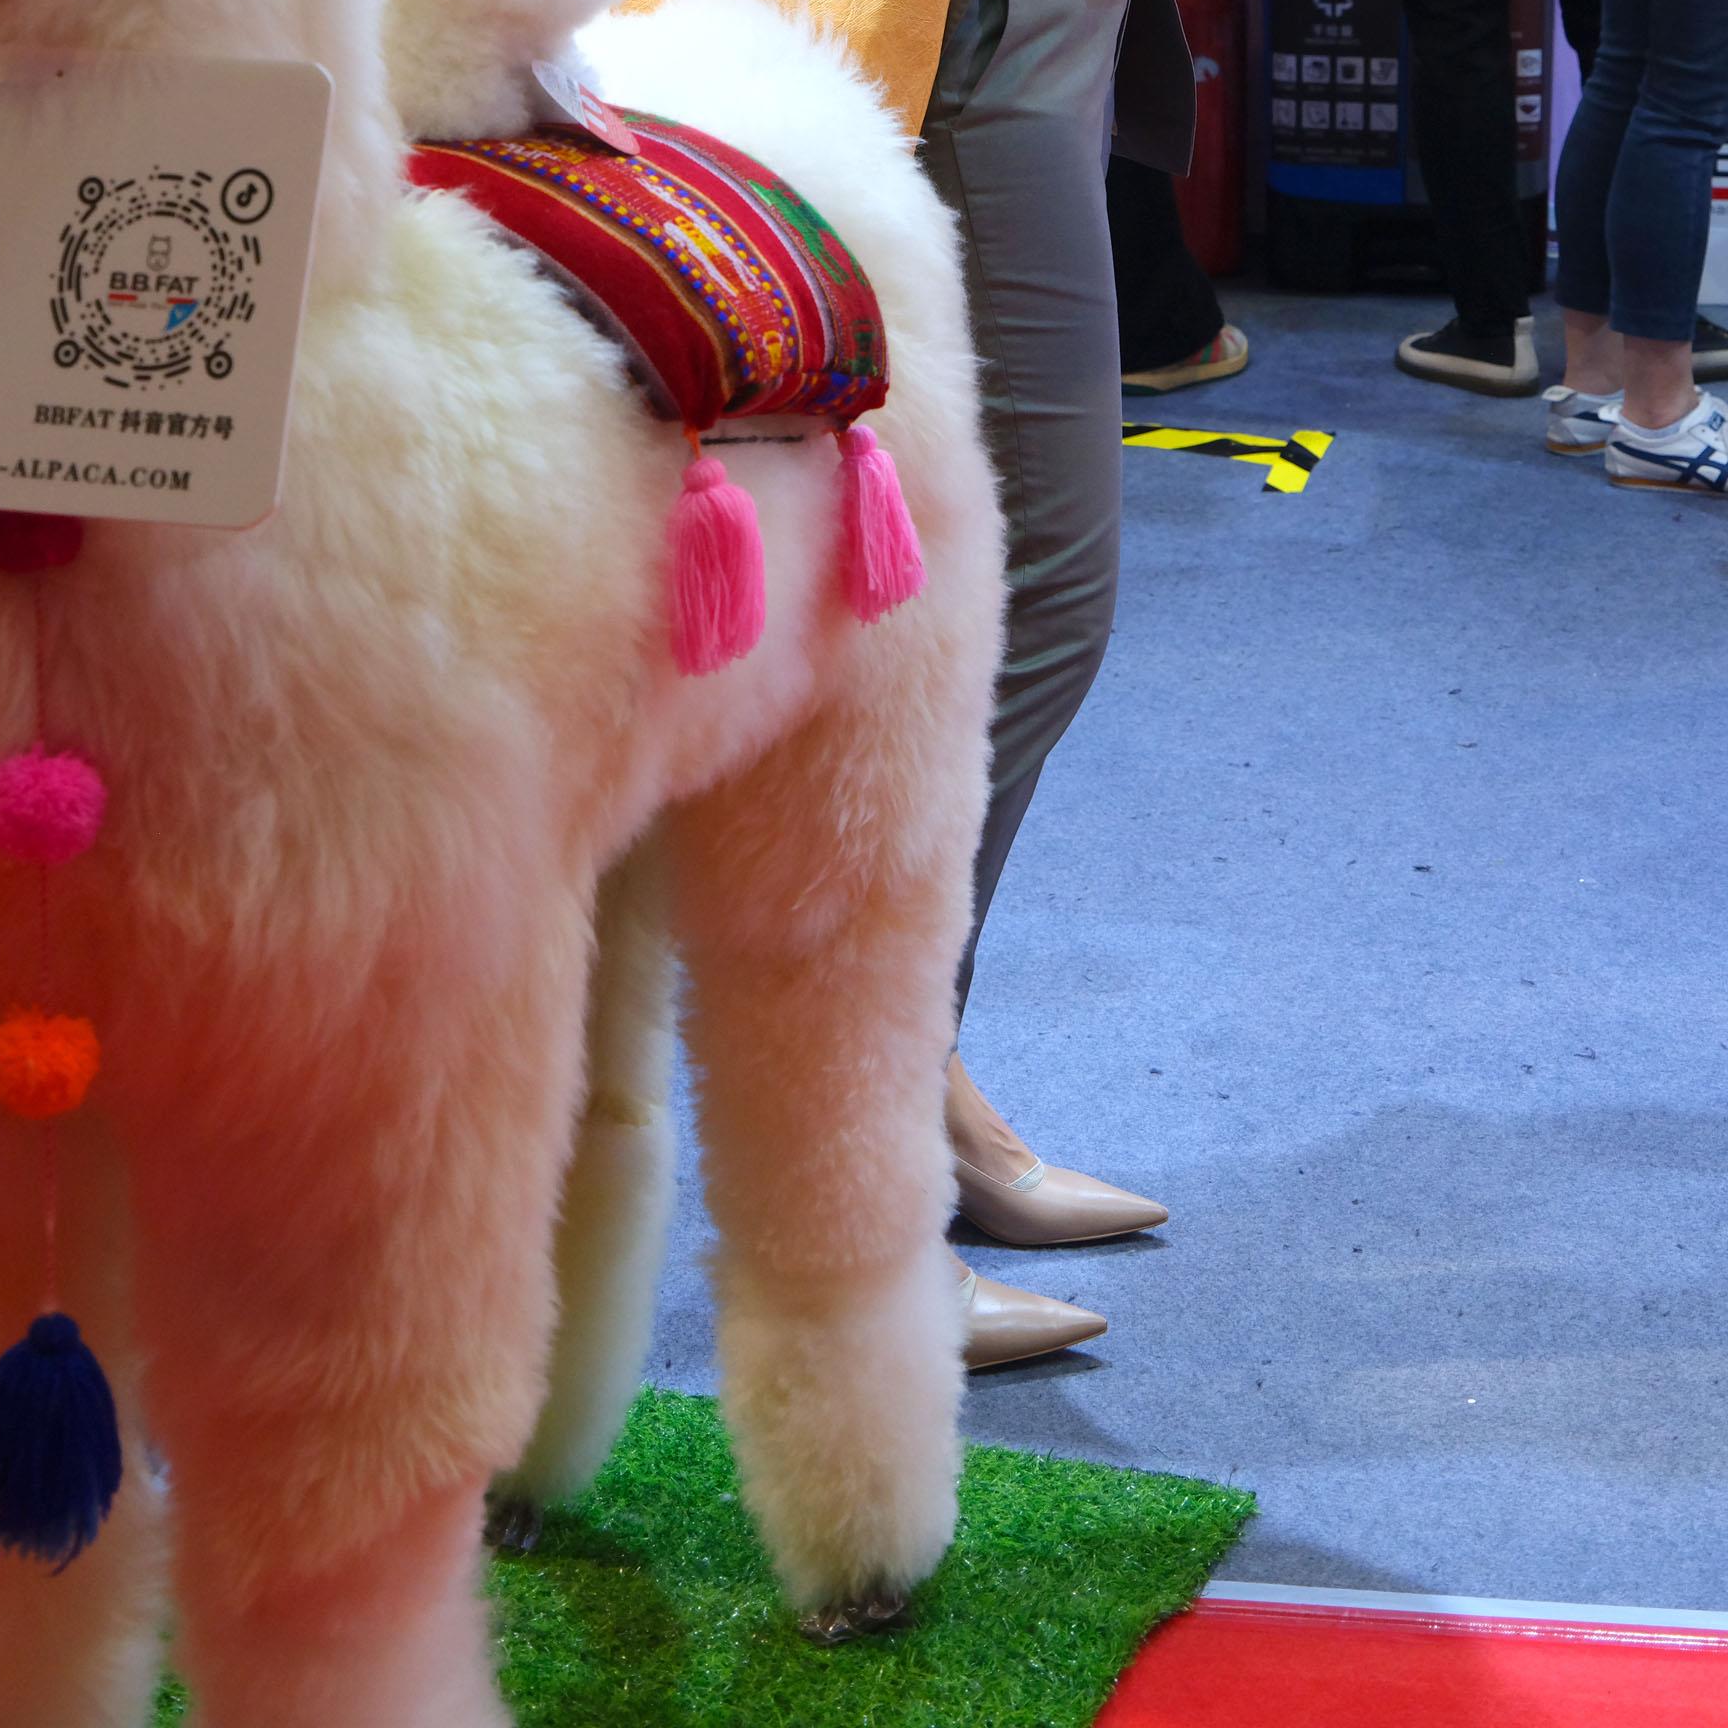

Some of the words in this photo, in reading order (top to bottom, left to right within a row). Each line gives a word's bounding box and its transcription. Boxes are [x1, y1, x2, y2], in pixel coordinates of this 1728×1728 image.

[109, 271, 200, 295] B.B.FAT
[33, 404, 116, 429] BBFAT
[119, 407, 236, 441] 抖音官方号
